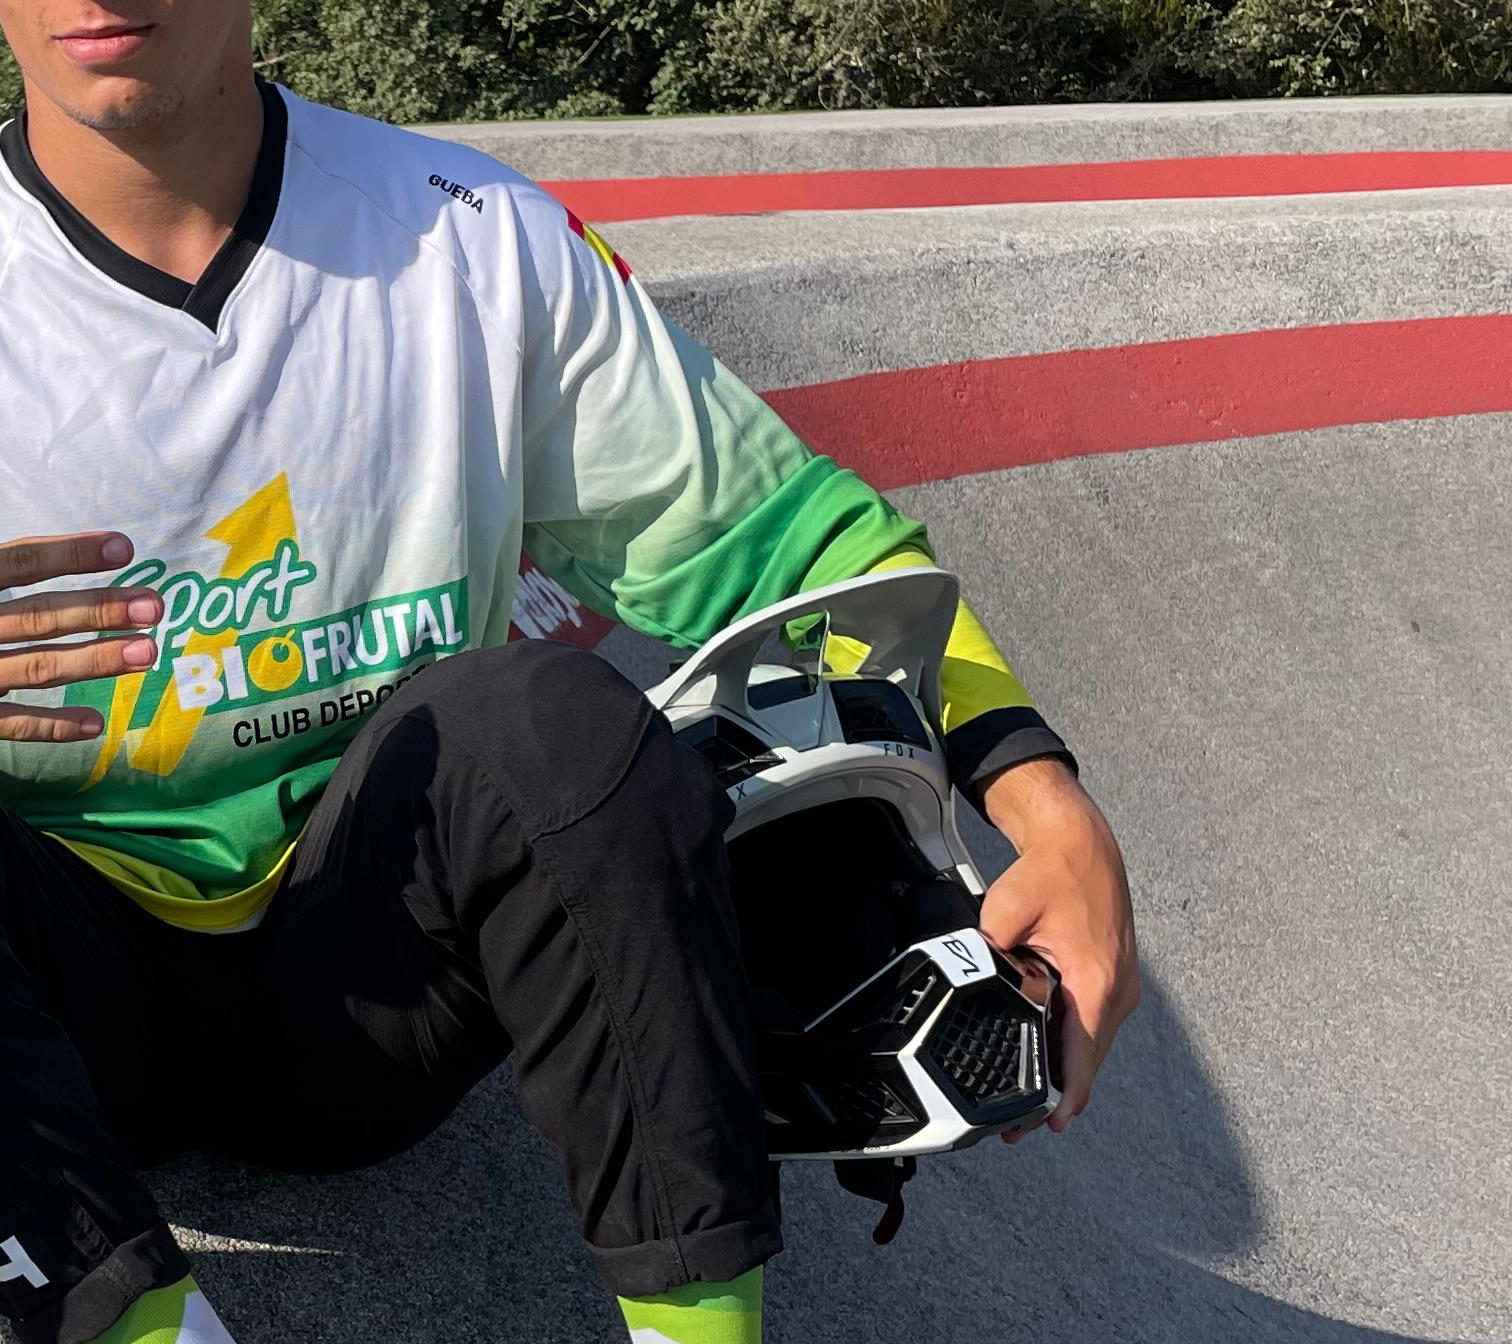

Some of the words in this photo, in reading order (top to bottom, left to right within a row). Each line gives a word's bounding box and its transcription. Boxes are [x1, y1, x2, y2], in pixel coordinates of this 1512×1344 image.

[232, 706, 312, 748] CLUB
[320, 657, 442, 729] DEPO
[882, 742, 916, 760] FOX
